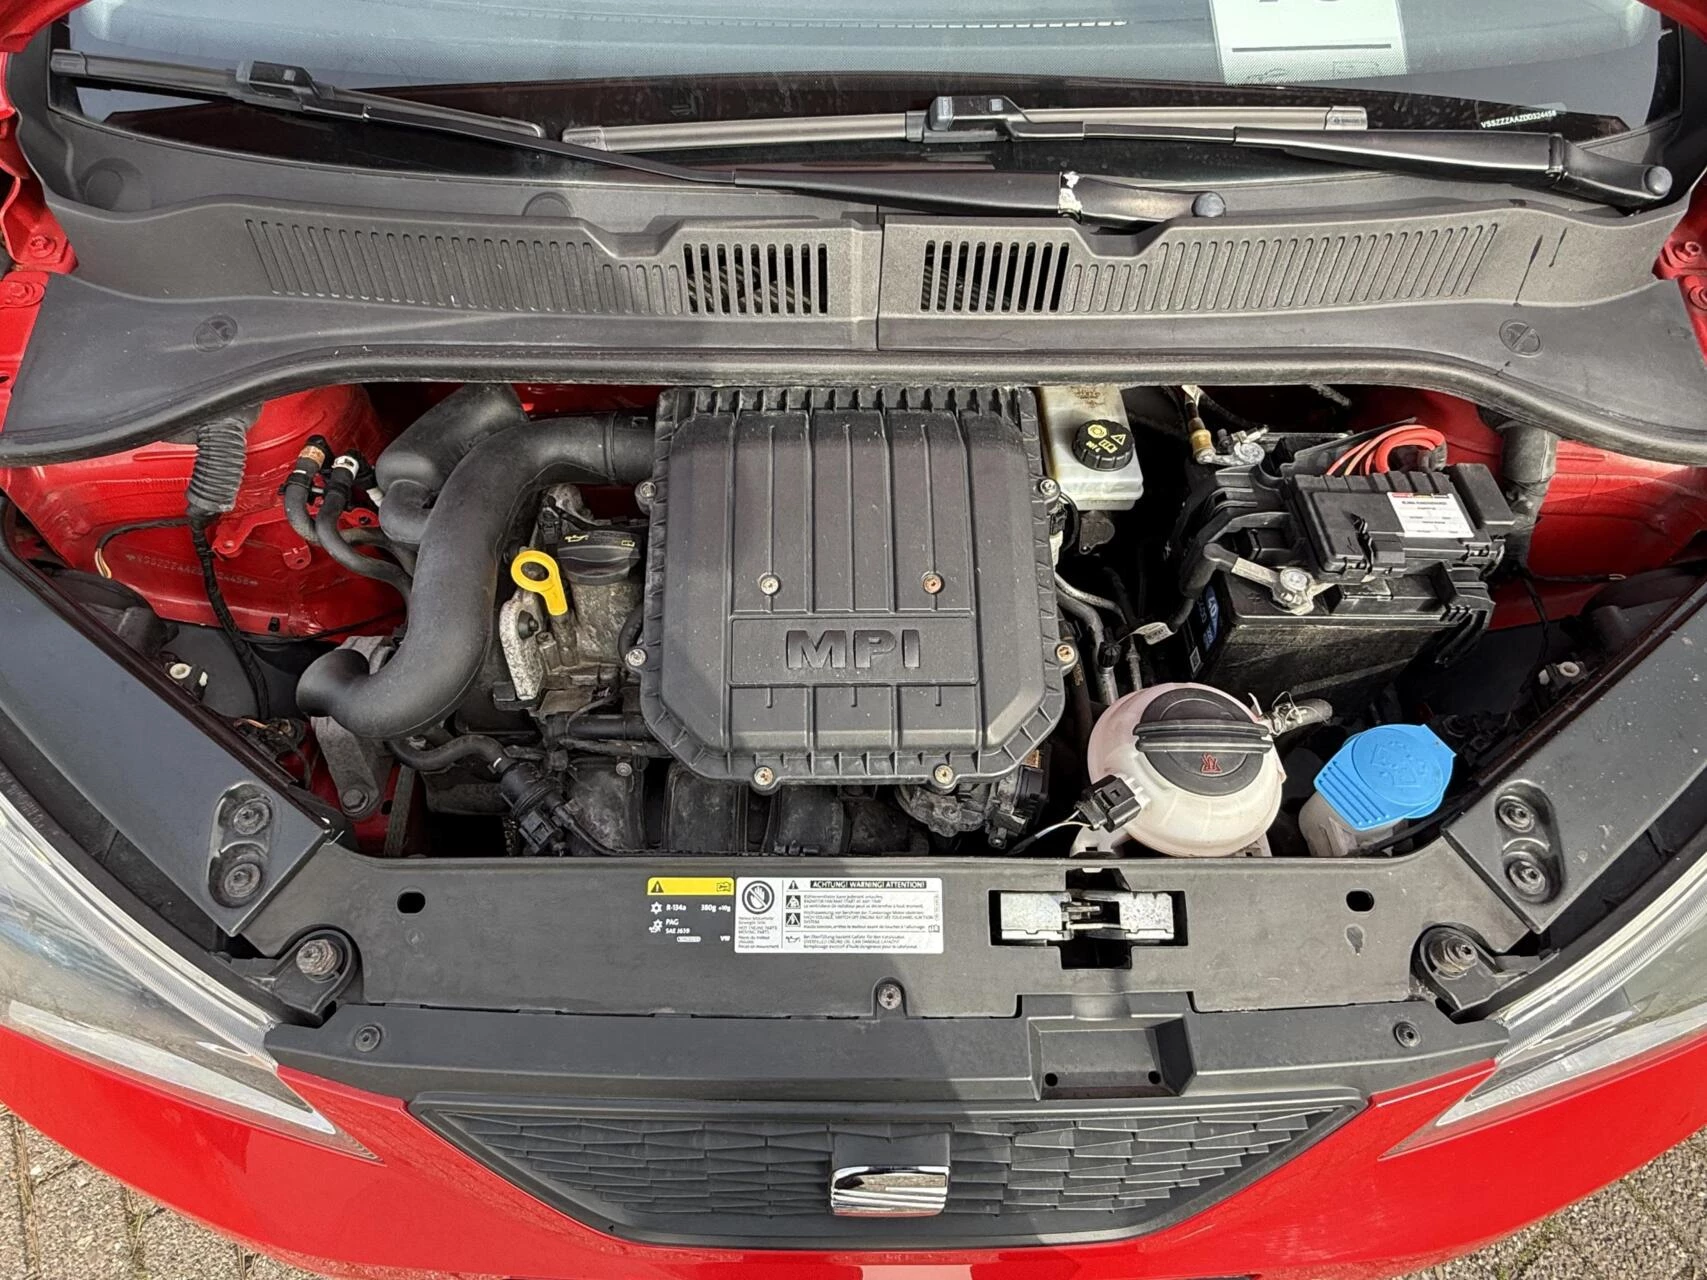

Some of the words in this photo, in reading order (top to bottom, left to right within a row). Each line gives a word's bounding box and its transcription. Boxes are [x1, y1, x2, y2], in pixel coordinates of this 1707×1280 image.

[786, 629, 921, 669] MPI
[665, 903, 687, 911] R-134a
[665, 918, 679, 926] PAG
